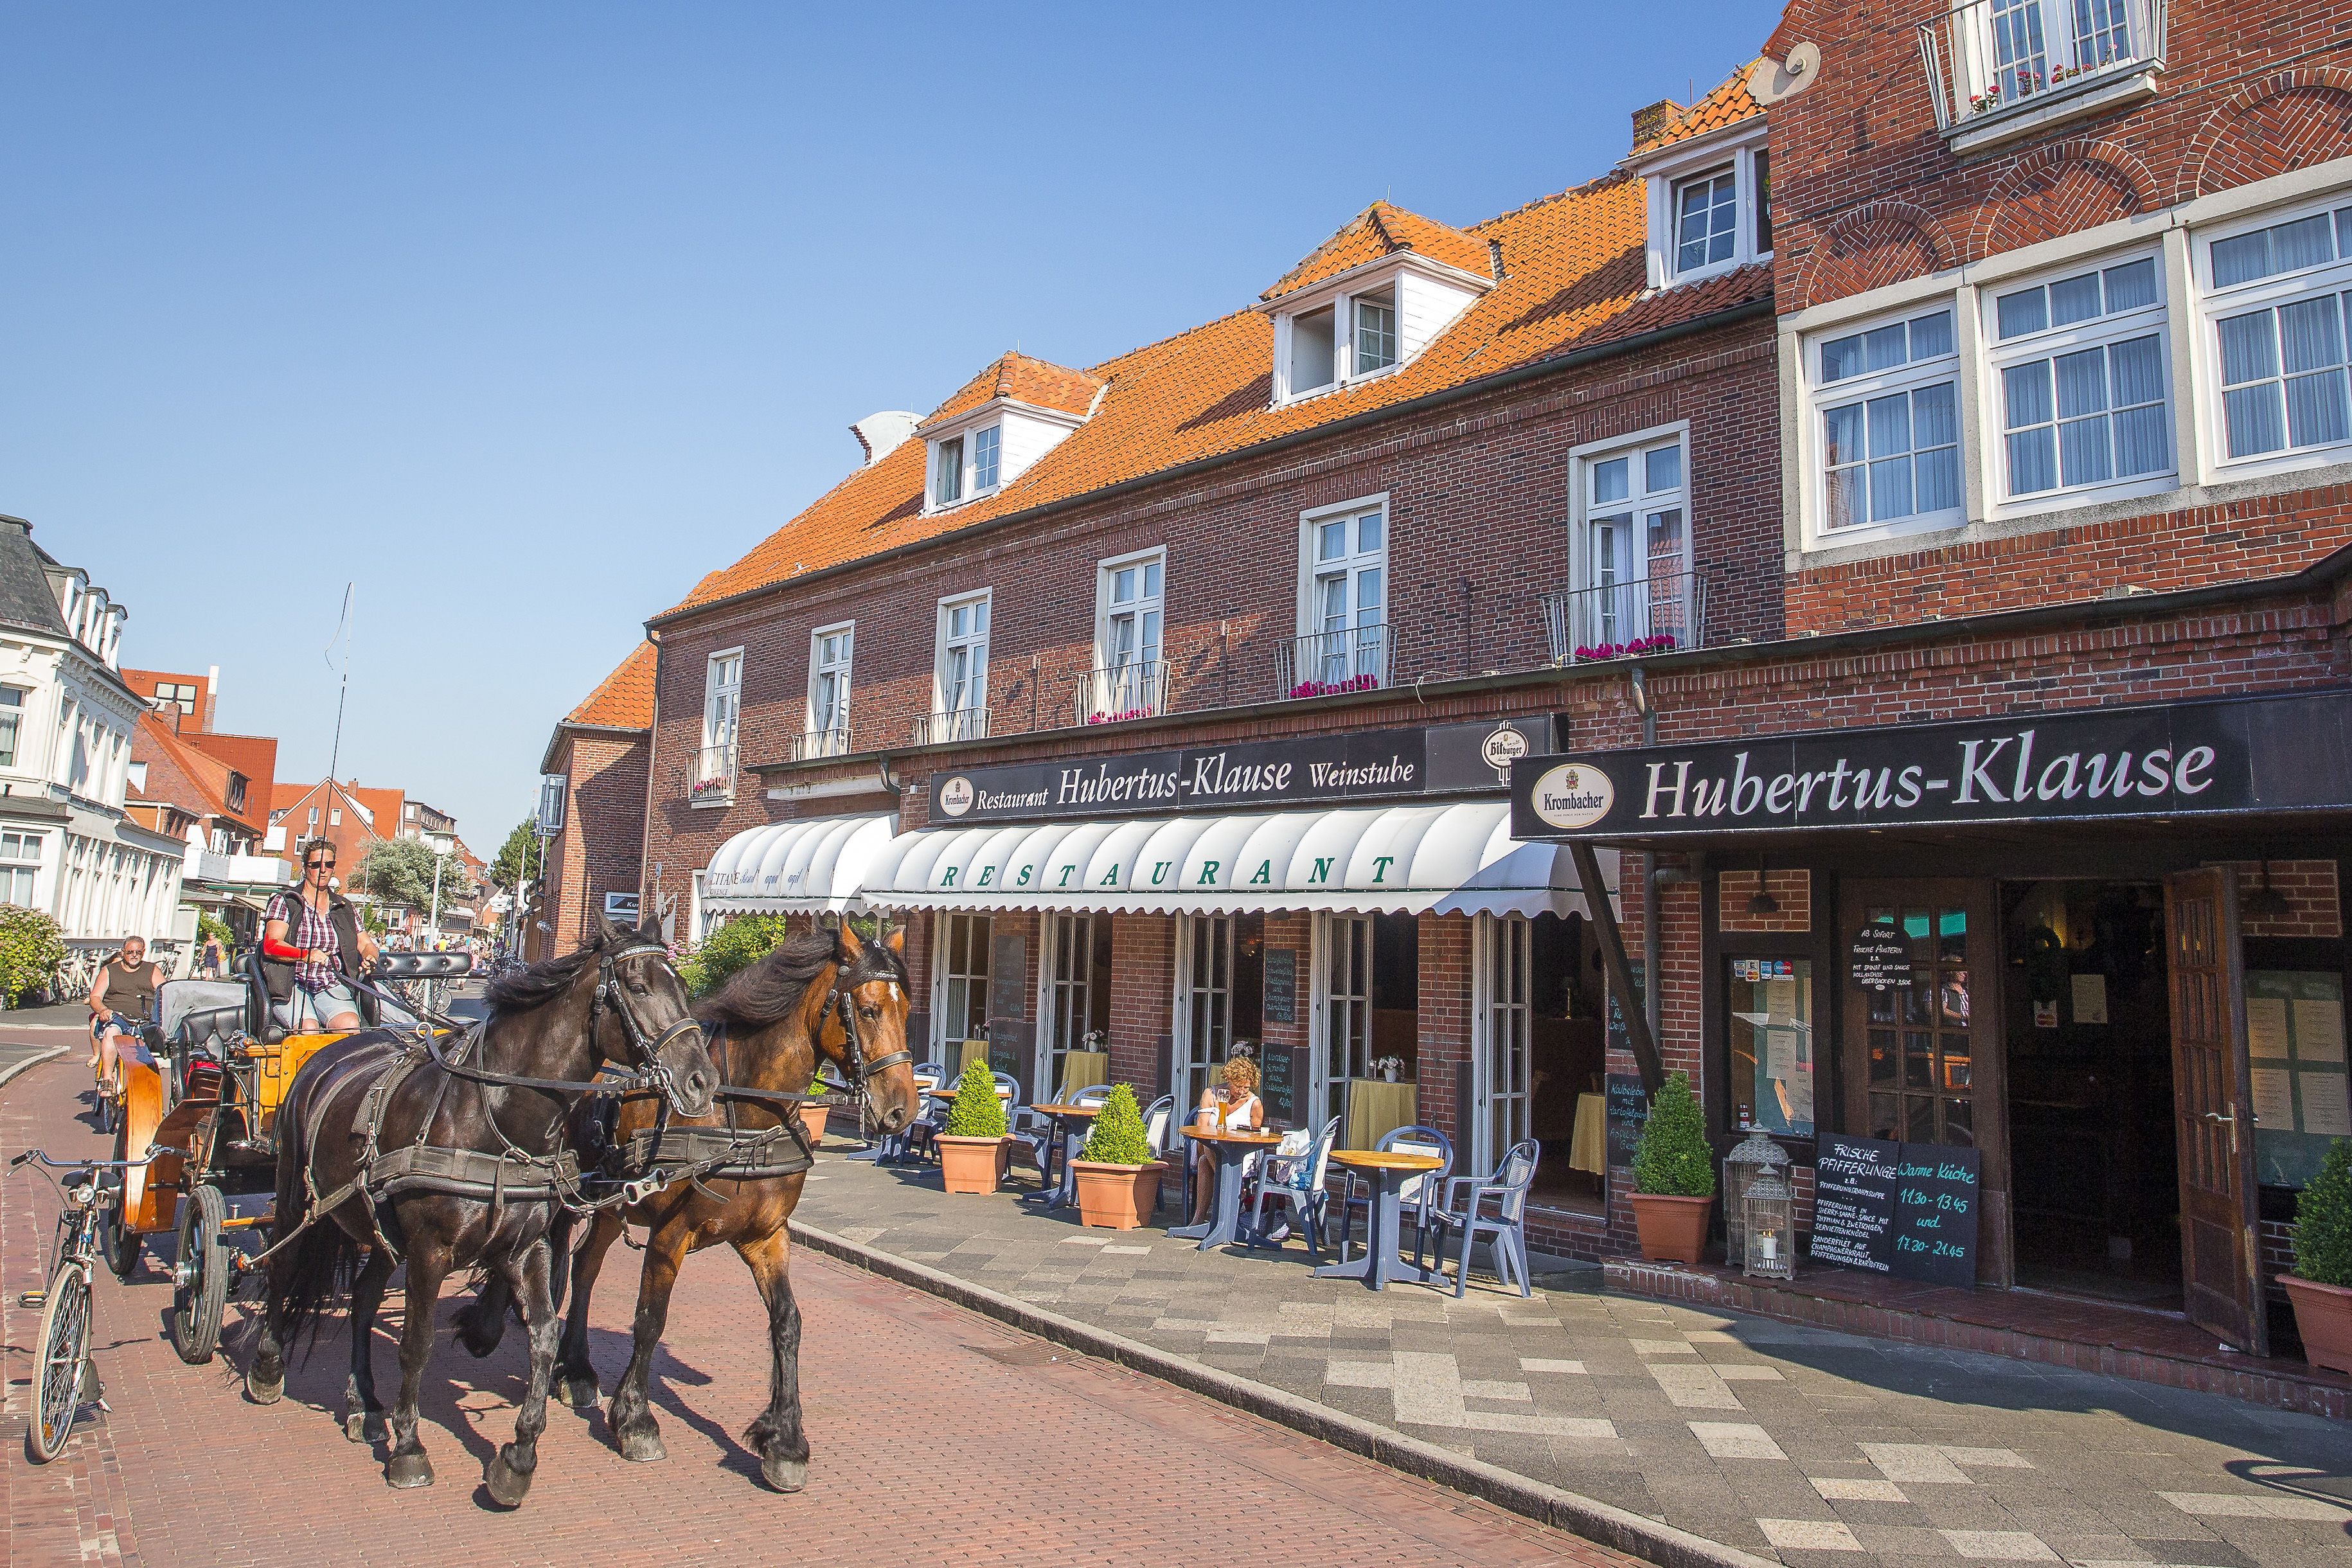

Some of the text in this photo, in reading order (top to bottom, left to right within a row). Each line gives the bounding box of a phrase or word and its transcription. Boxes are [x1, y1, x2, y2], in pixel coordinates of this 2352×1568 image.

[1490, 742, 1522, 756] Bitburger
[976, 752, 1414, 810] Restaurant Hubertus-Klause Weinstube
[1639, 729, 2214, 819] Hubertus-Klause
[1544, 791, 1604, 810] Krombacher
[711, 872, 740, 886] CITANE
[1834, 1144, 1880, 1162] FRISCHE
[1936, 1162, 1975, 1184] Küche
[1936, 1193, 1968, 1213] 13.45
[1878, 1216, 1889, 1225] MIT
[1916, 1215, 1941, 1228] und
[1932, 1240, 1965, 1258] 21.45
